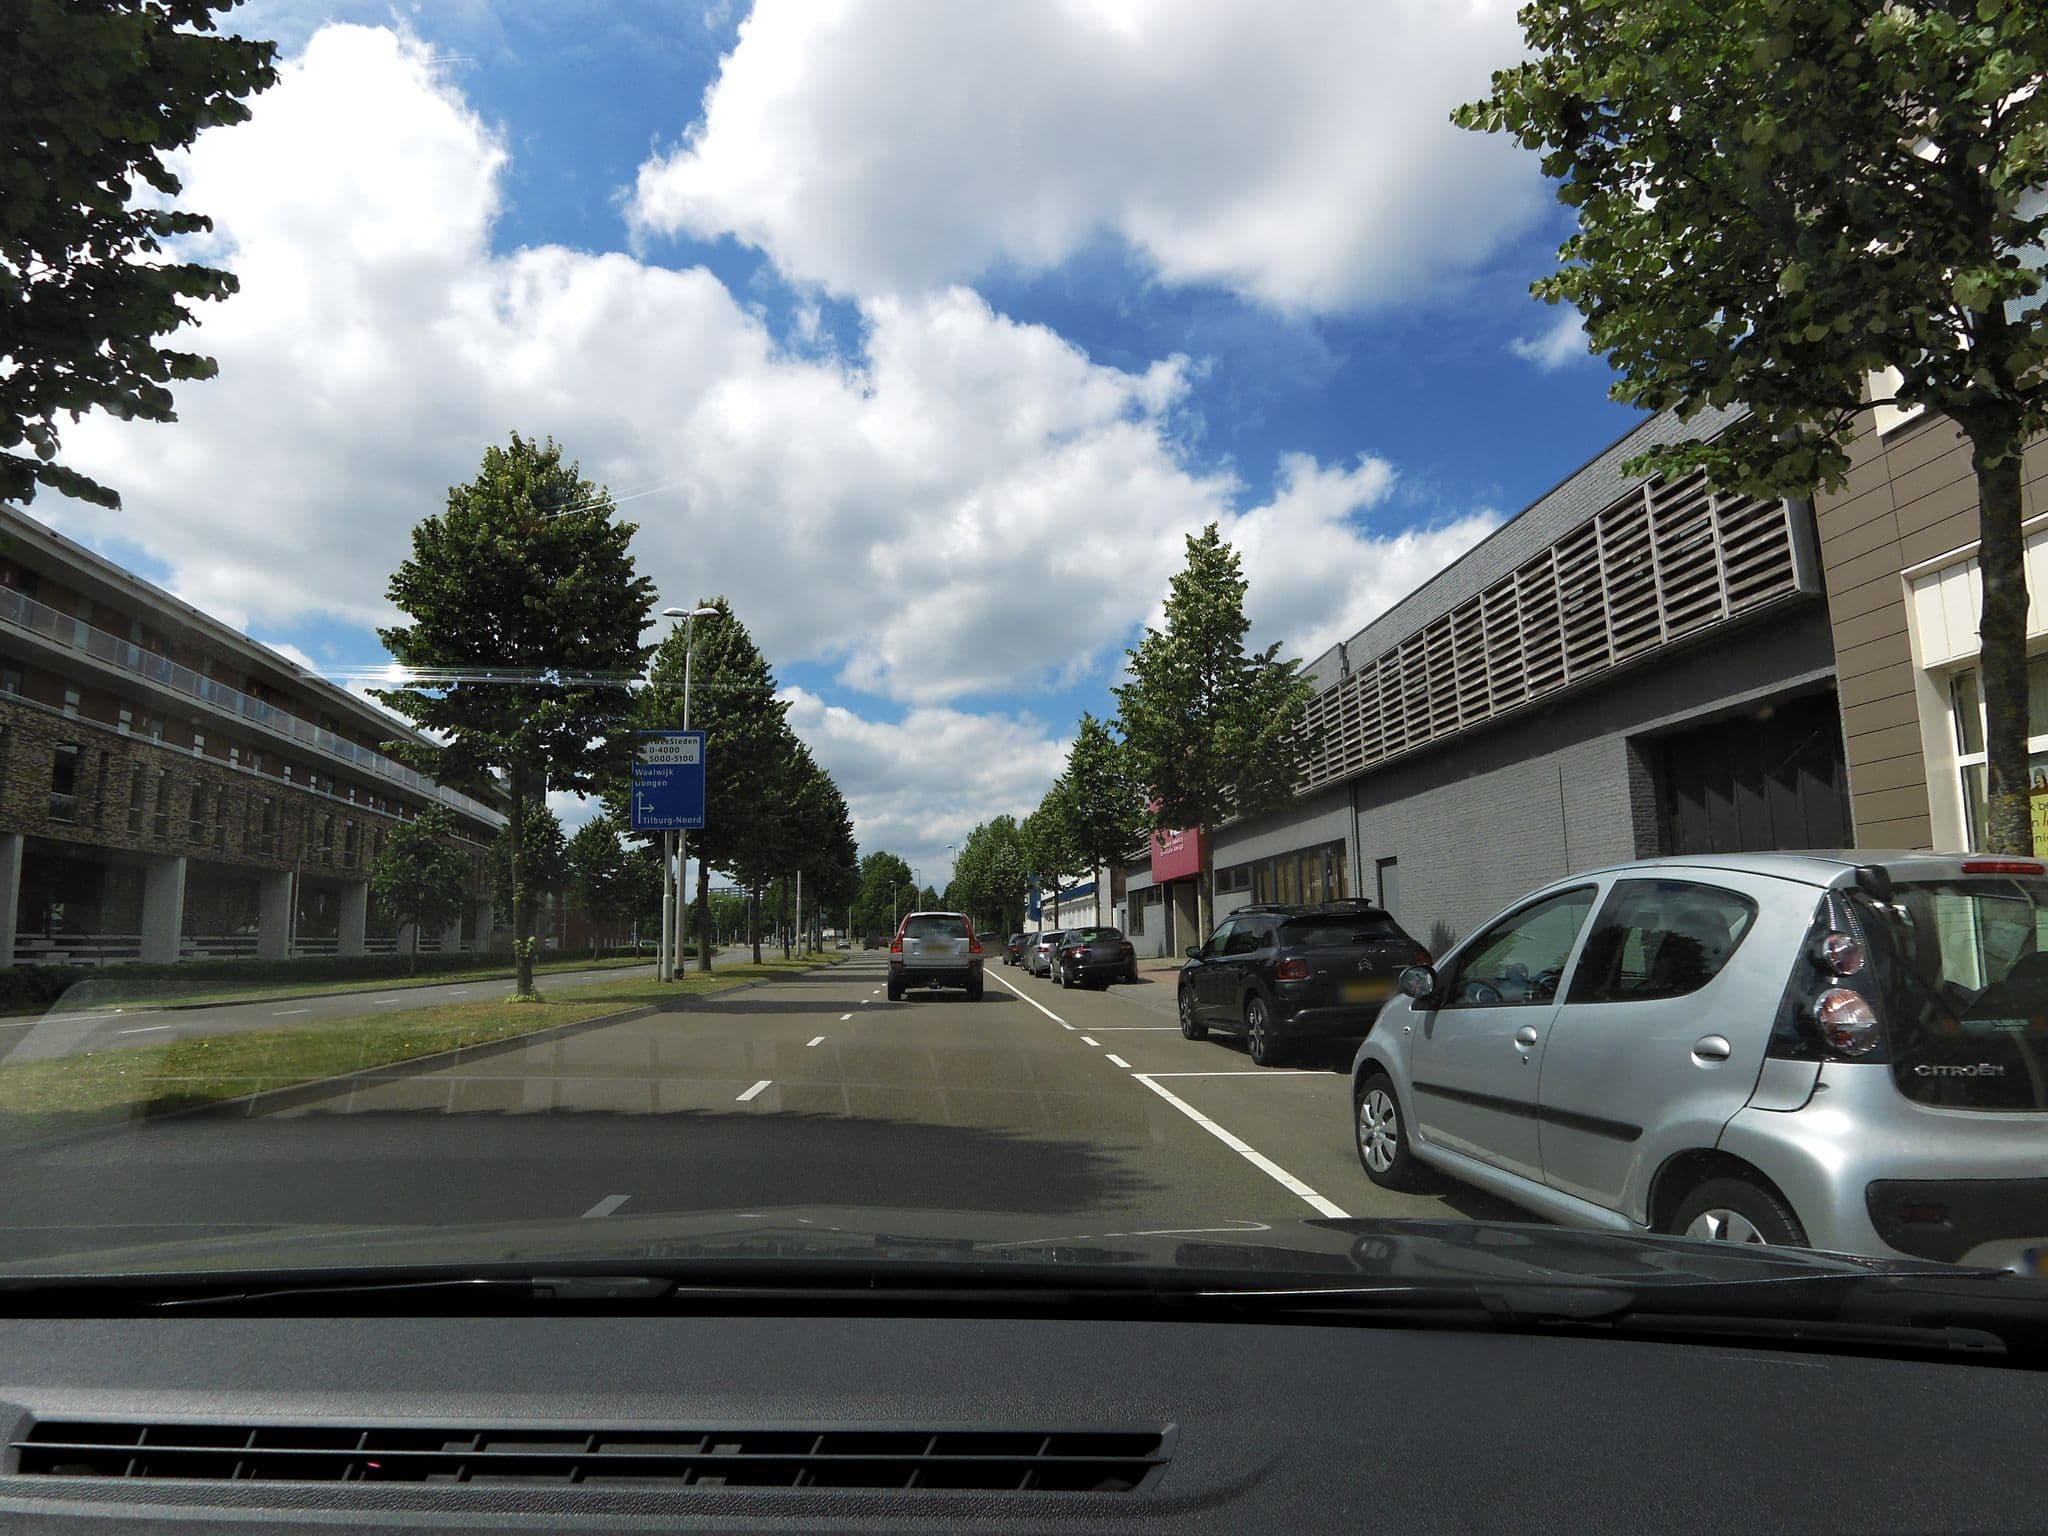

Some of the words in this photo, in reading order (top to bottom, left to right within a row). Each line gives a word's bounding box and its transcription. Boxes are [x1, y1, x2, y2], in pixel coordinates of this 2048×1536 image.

[635, 768, 674, 778] Waalwijk
[643, 816, 702, 825] Tilburg-Noord
[1913, 1063, 2005, 1077] CITROËN
